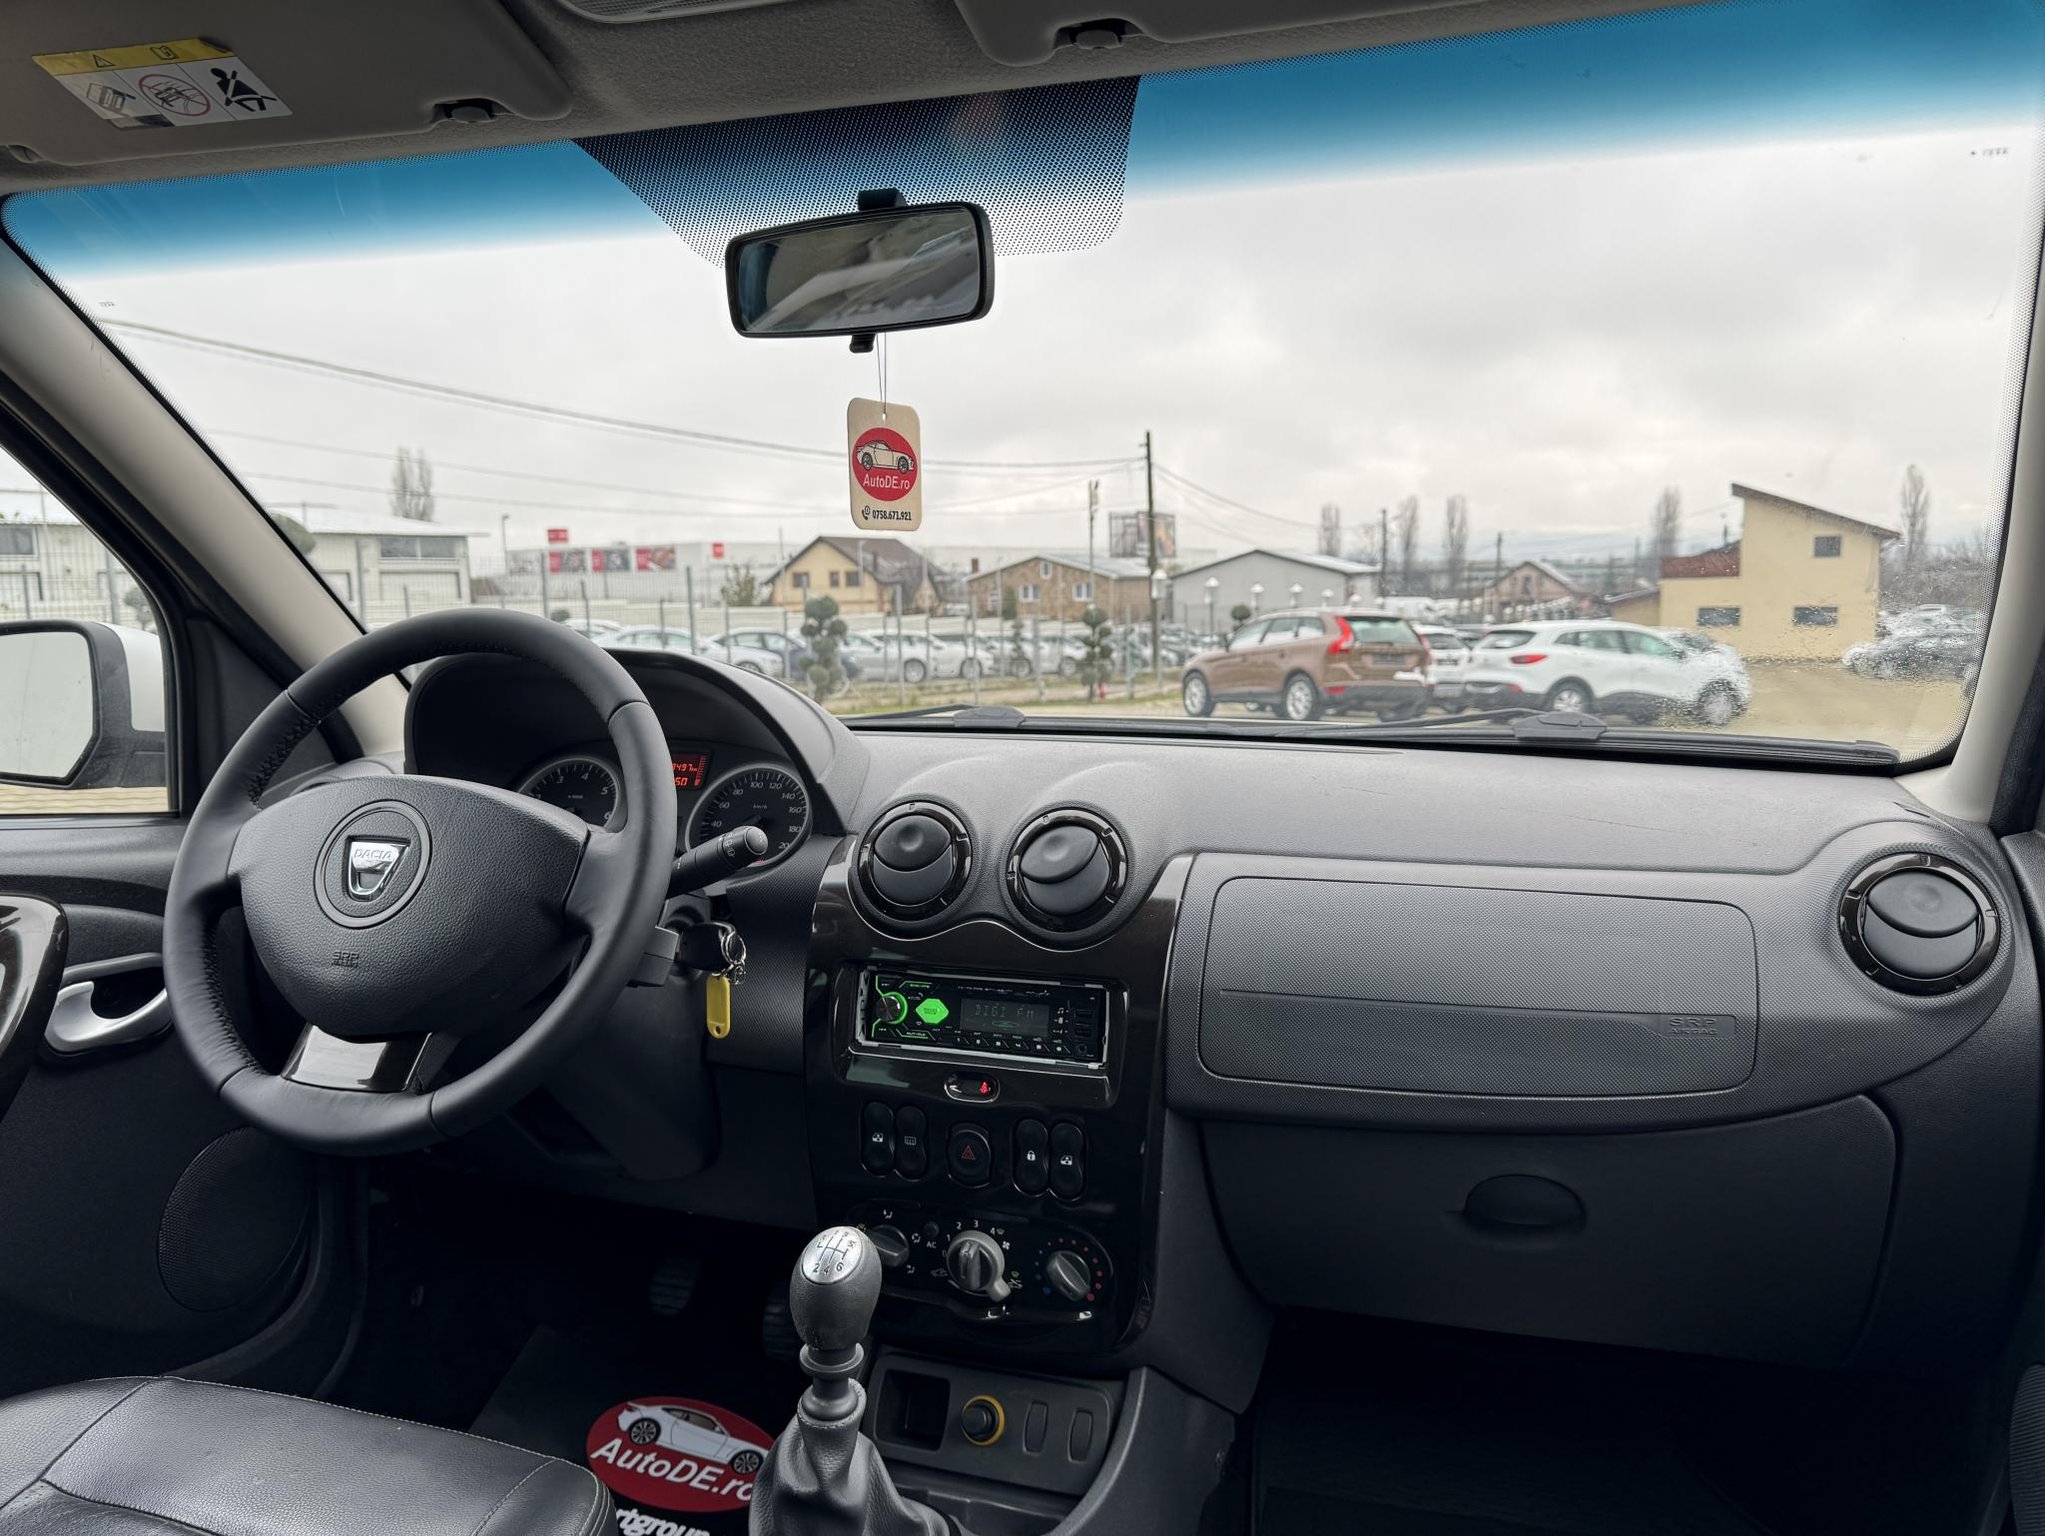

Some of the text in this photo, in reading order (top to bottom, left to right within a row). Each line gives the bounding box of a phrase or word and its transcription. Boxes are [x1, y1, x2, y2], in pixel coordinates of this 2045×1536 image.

[863, 474, 910, 489] AutoDE.ro
[872, 510, 912, 520] 0758.671.921
[769, 782, 782, 790] 120
[600, 786, 609, 796] 5
[732, 788, 744, 796] 80
[781, 792, 795, 800] 140
[788, 806, 802, 814] 160
[788, 825, 802, 833] 180
[353, 848, 392, 860] DACIA
[1669, 1017, 1717, 1026] SRP
[956, 1221, 962, 1230] 2
[973, 1219, 979, 1228] 3
[990, 1227, 996, 1235] 4
[946, 1234, 951, 1242] 1
[926, 1241, 937, 1249] AC
[812, 1262, 820, 1273] 2
[836, 1261, 845, 1272] 6
